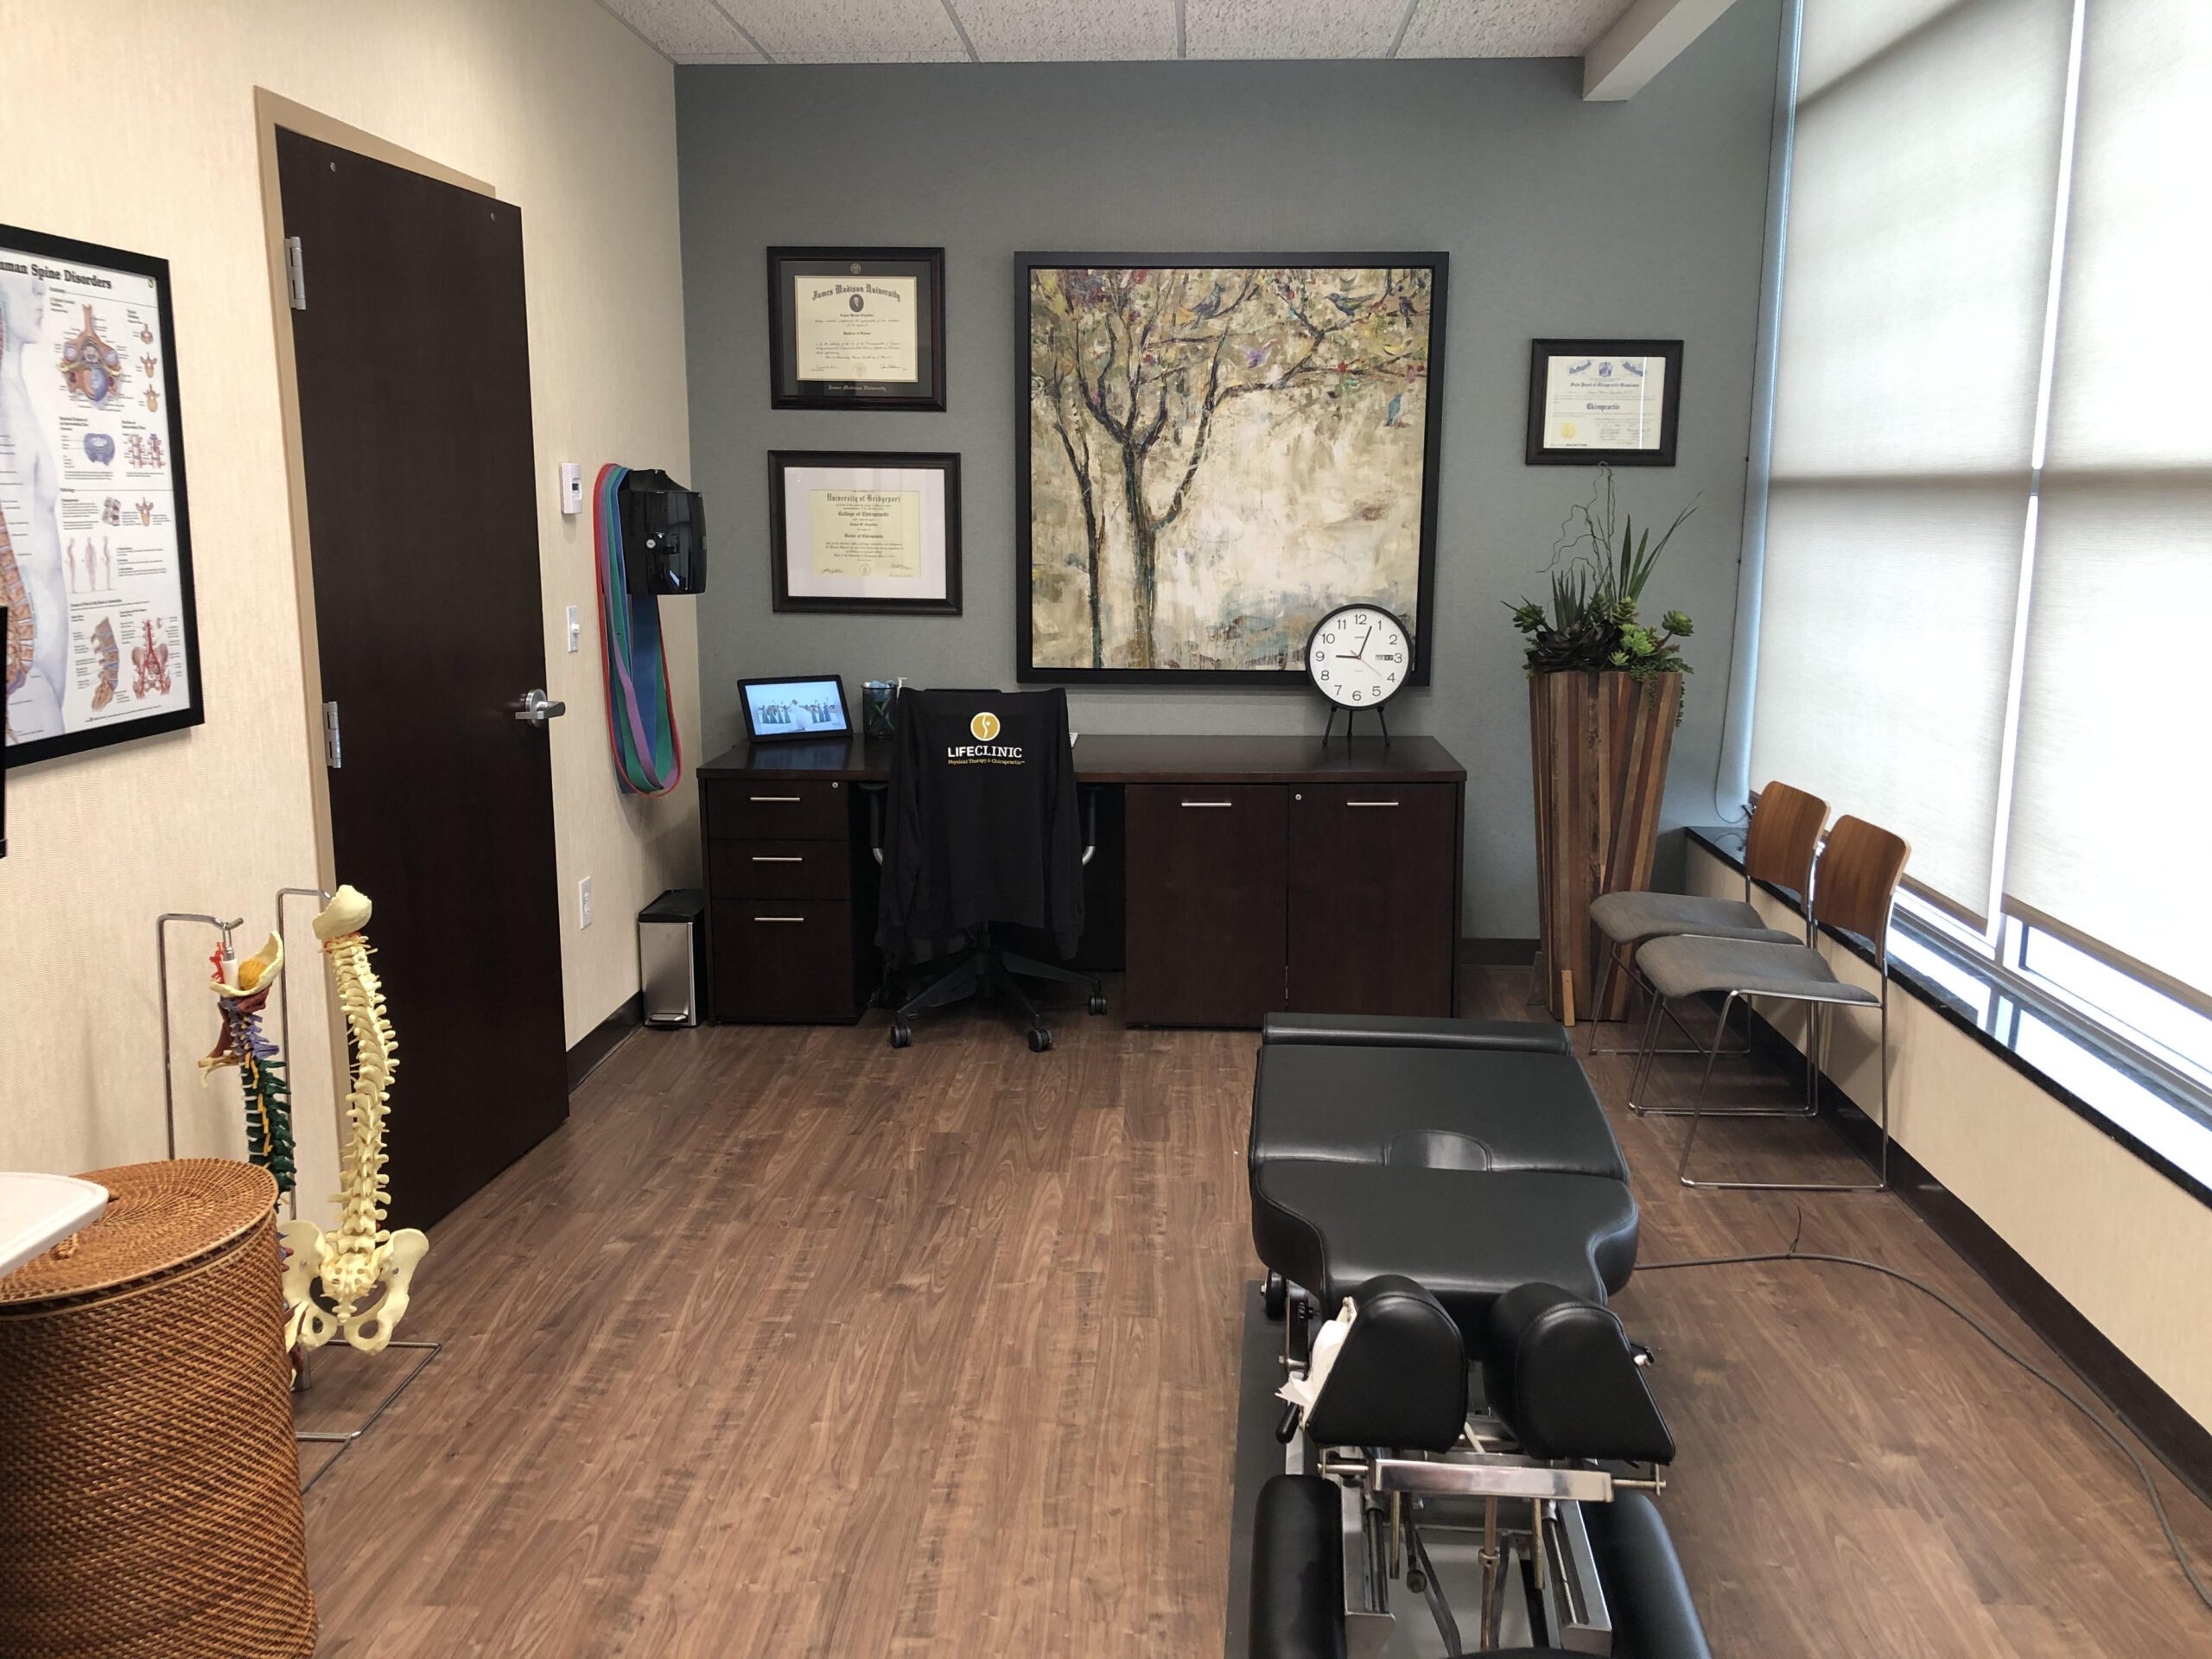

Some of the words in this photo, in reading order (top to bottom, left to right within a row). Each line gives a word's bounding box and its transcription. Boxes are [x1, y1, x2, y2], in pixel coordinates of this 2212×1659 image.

[0, 261, 28, 275] uman
[31, 264, 60, 281] Spine
[63, 269, 112, 289] Disorders
[812, 289, 834, 301] James
[835, 284, 864, 295] Madison
[866, 283, 901, 302] University
[1586, 403, 1620, 411] Chiropractic
[827, 493, 858, 503] University
[867, 494, 900, 504] Bridgeport
[1337, 619, 1346, 630] 11
[1355, 614, 1367, 625] 12
[1377, 620, 1382, 631] 1
[1322, 633, 1335, 644] 10
[1389, 634, 1397, 645] 2
[1315, 651, 1325, 662] 9
[1394, 652, 1403, 664] 3
[1320, 670, 1330, 681] 8
[1387, 671, 1395, 683] 4
[1334, 684, 1343, 696] 7
[1371, 686, 1381, 696] 5
[1352, 690, 1362, 702] 6
[947, 745, 1023, 759] LIFECLINIC
